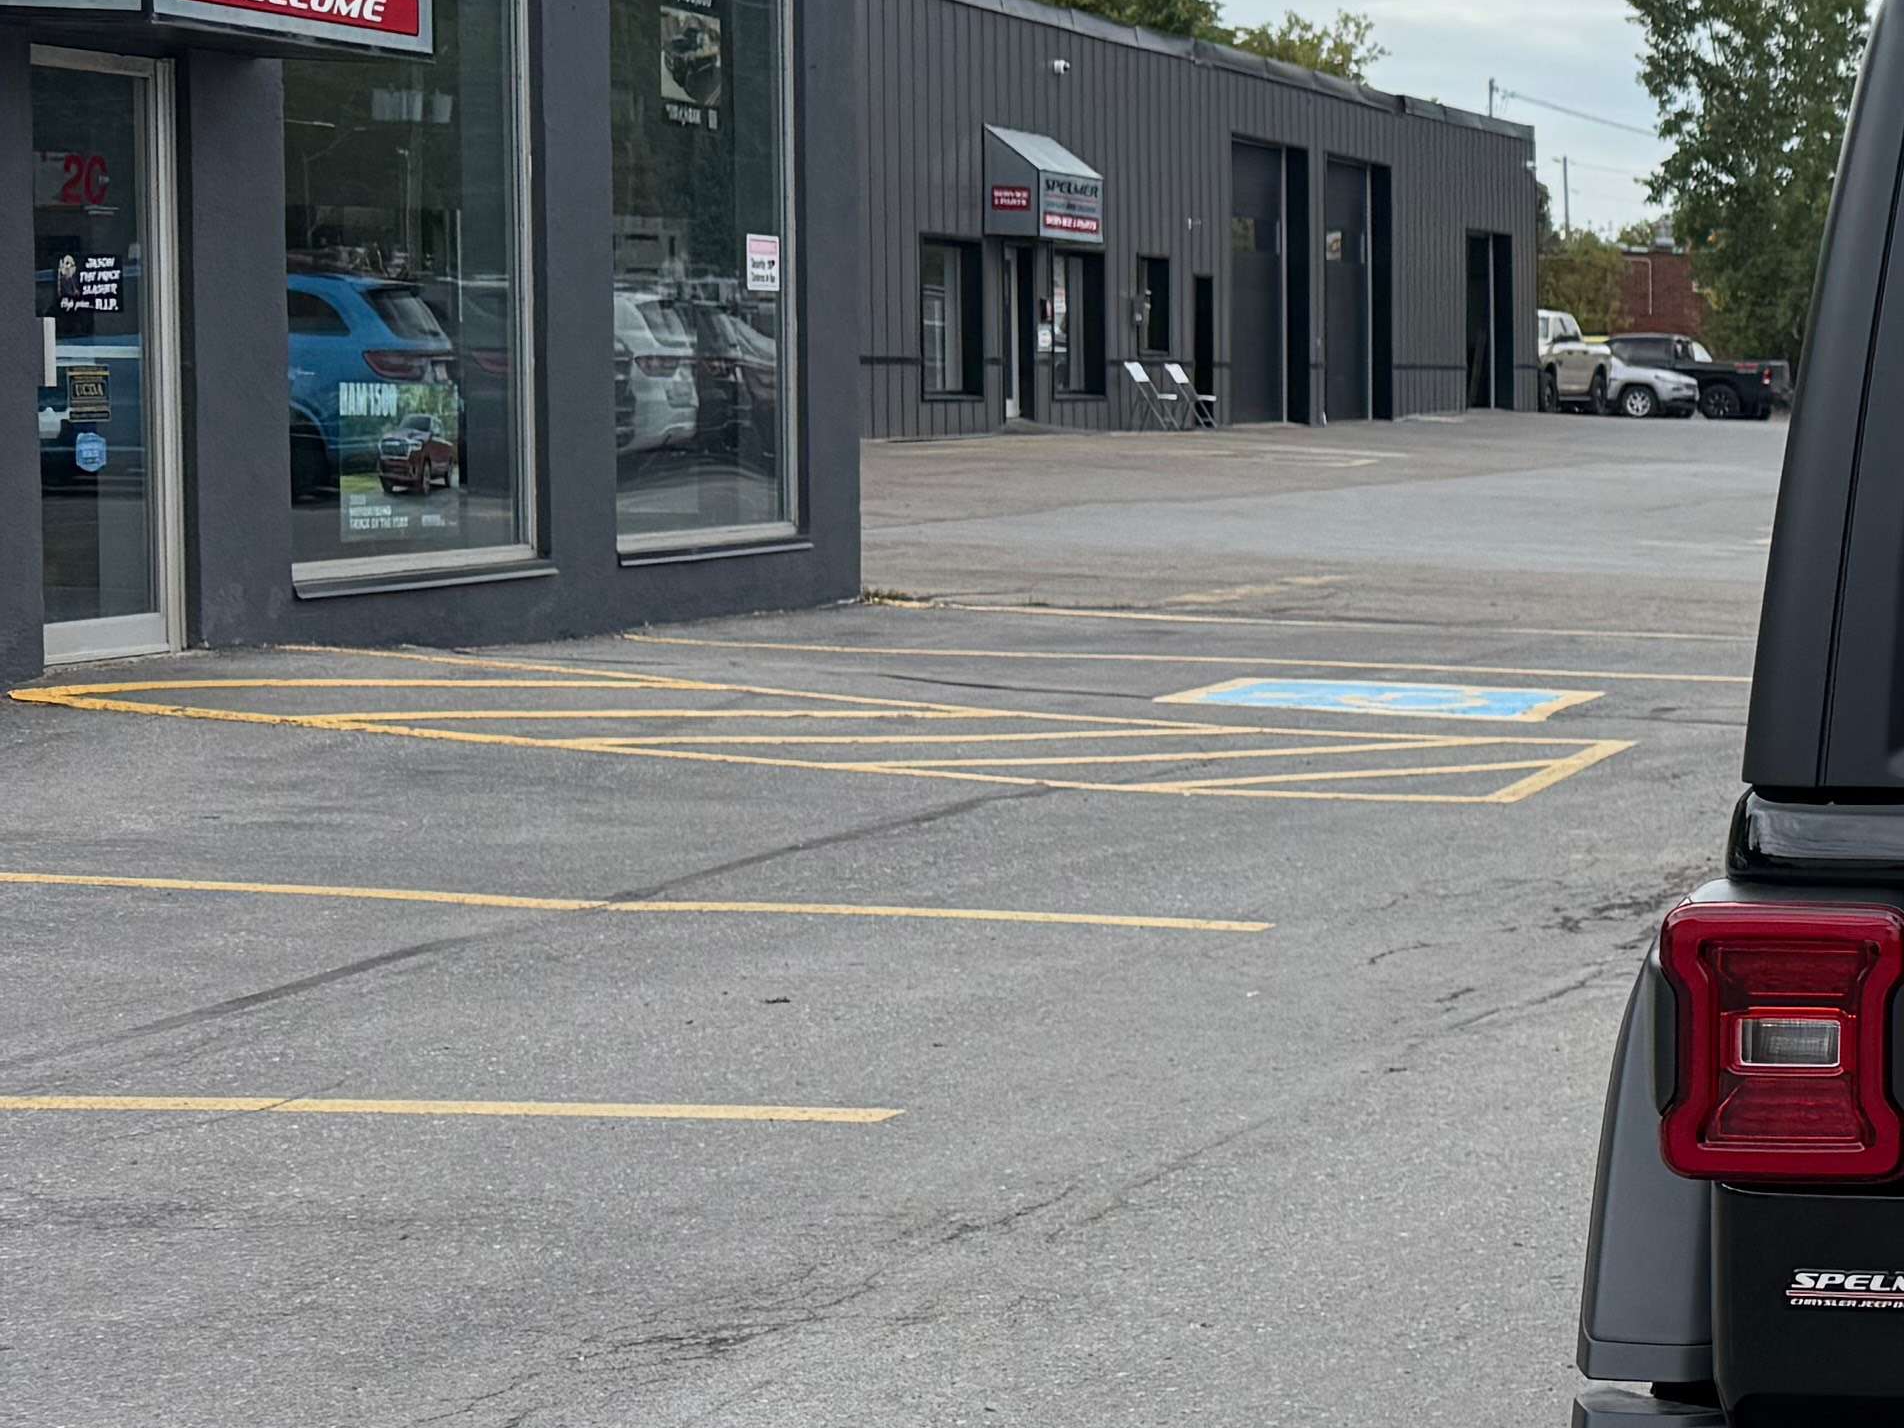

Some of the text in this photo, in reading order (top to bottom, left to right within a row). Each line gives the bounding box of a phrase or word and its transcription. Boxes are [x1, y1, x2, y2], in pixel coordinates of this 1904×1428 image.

[1045, 178, 1099, 199] SPELMER
[1790, 1298, 1857, 1308] CHRYSLER
[1858, 1300, 1893, 1309] JEEP
